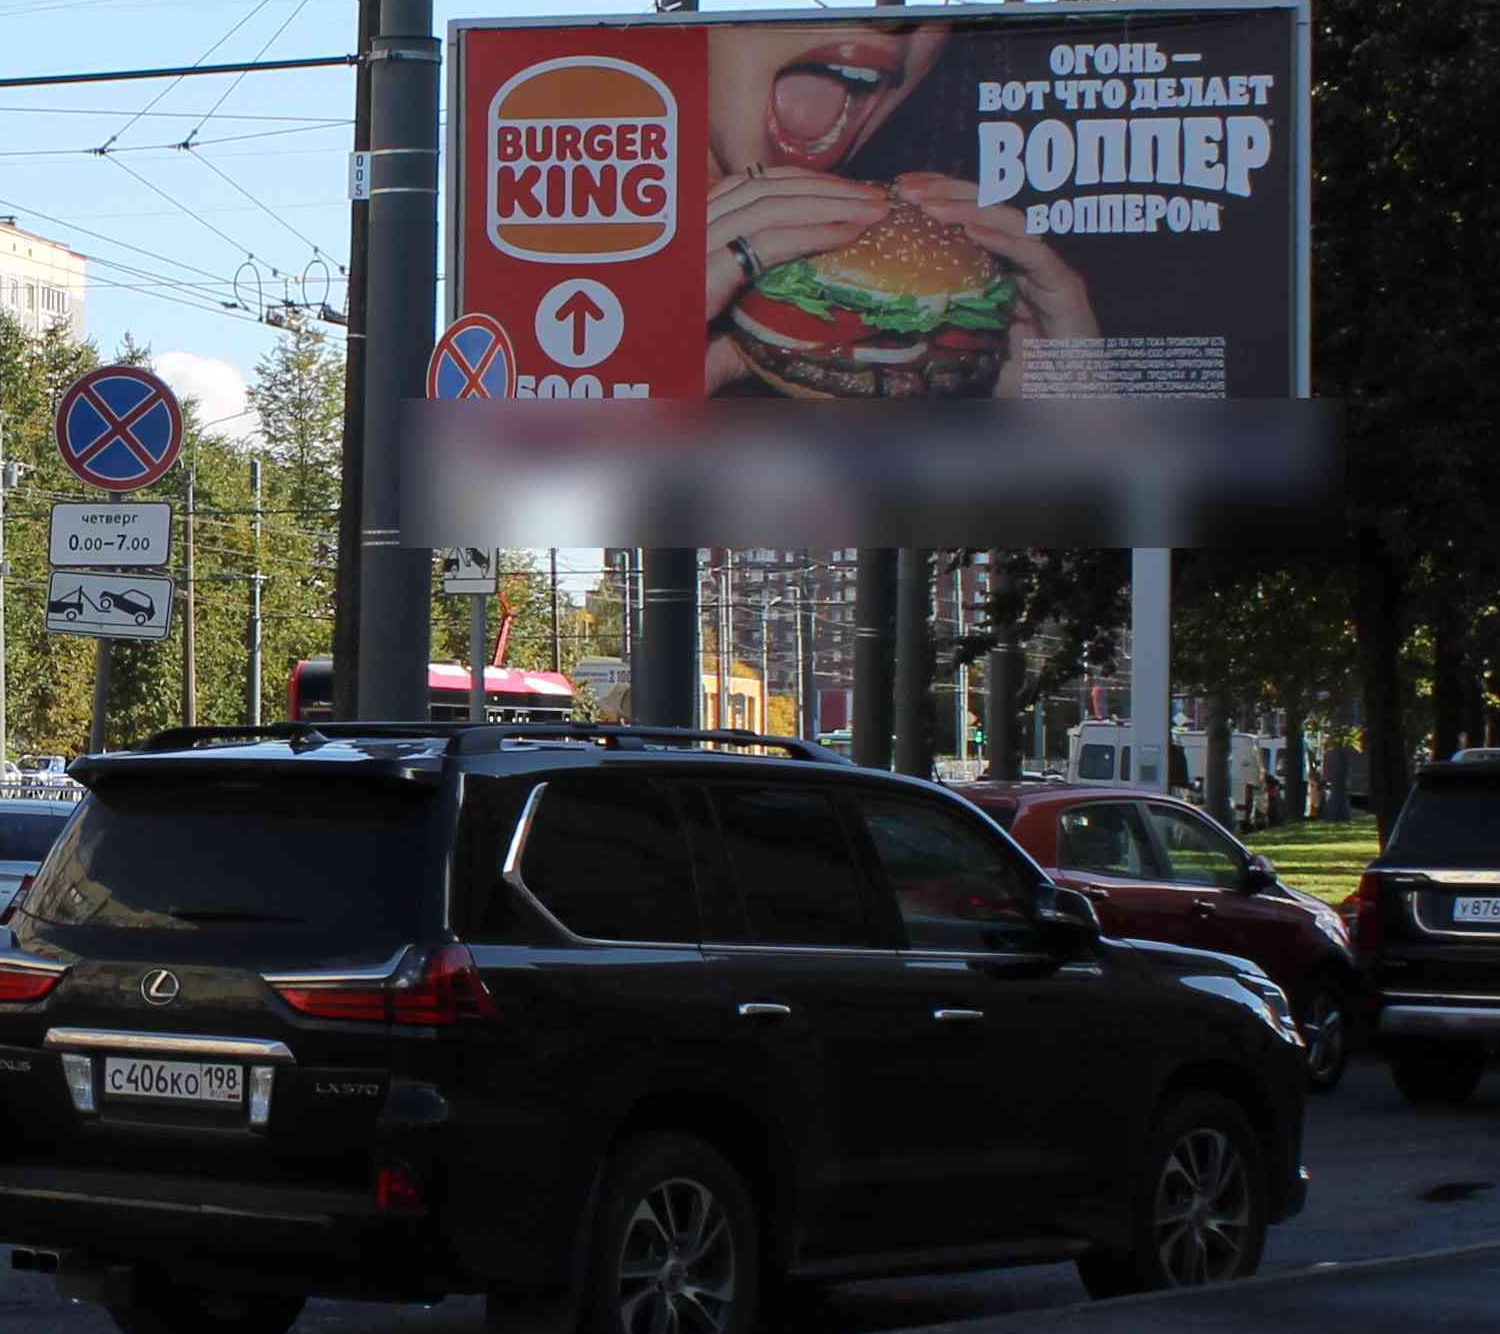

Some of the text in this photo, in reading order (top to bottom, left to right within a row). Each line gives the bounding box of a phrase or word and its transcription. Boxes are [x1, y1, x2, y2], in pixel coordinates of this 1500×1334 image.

[1050, 43, 1167, 75] ОГОНЬ
[978, 75, 1274, 112] ВОТ ЧТО ДЕЛАЕТ
[497, 124, 668, 162] BURGER
[978, 116, 1271, 208] ВОППЕР
[497, 163, 668, 218] KING
[1026, 194, 1221, 234] ВОППЕРОМ
[81, 513, 140, 527] четверг
[203, 1066, 237, 1090] 198
